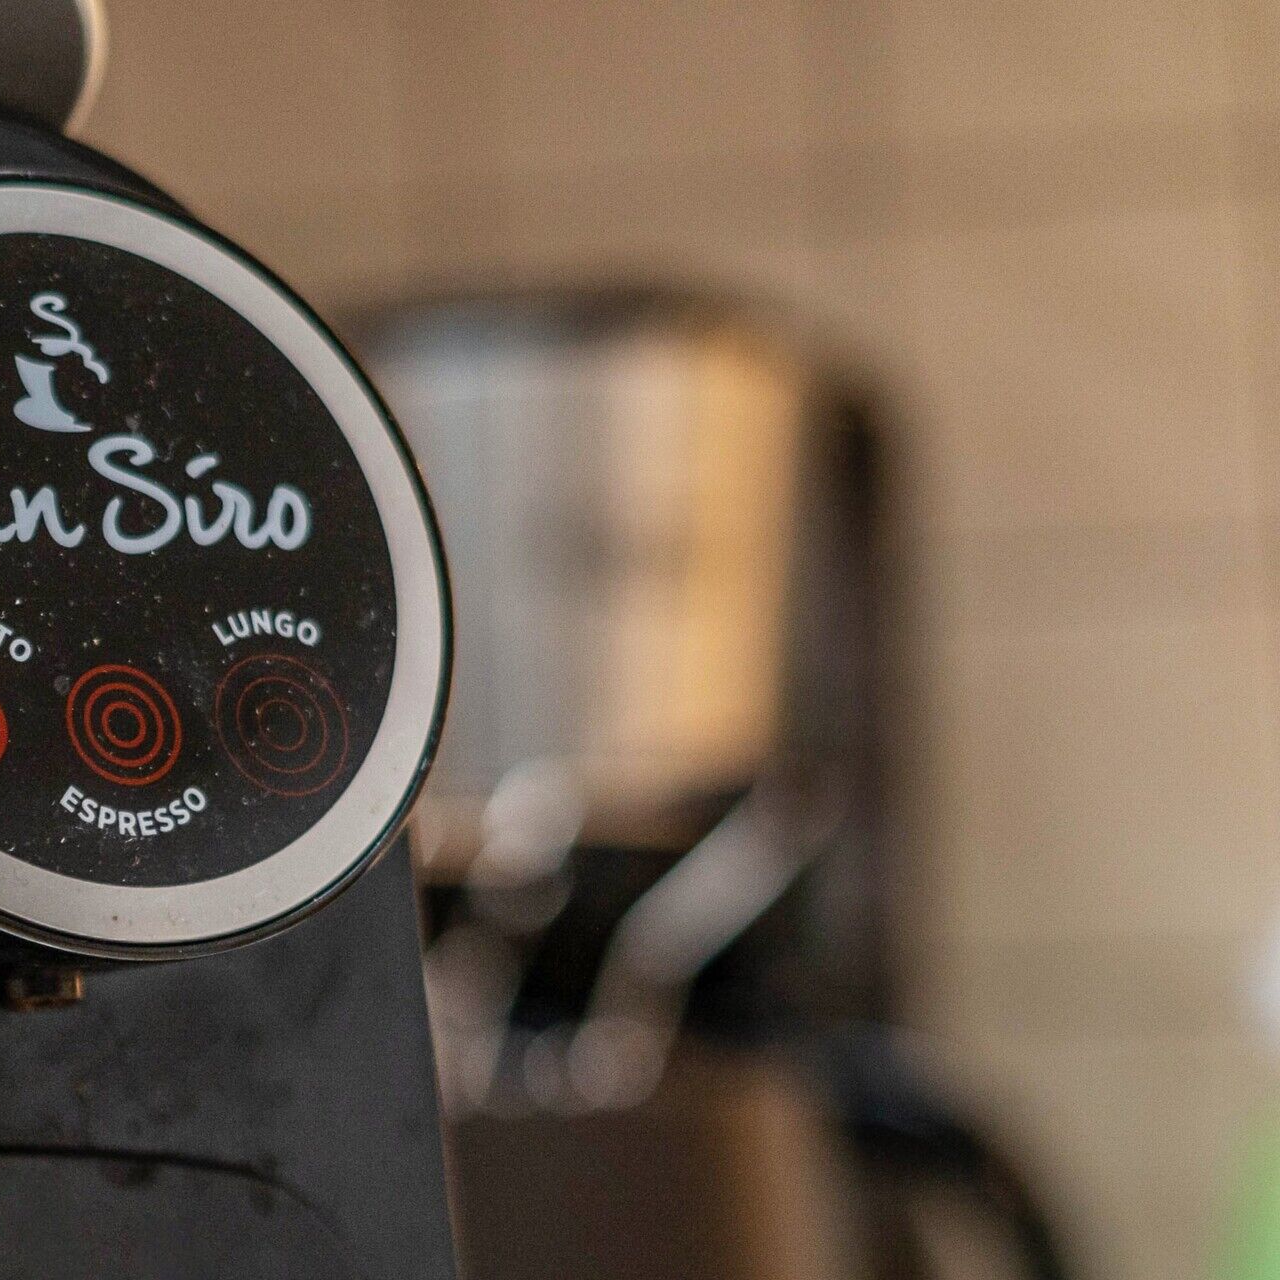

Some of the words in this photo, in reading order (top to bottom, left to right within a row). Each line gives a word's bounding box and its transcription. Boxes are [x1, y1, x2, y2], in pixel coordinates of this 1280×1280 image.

[88, 434, 308, 555] Siro
[210, 608, 322, 648] LUNGO
[58, 785, 208, 838] ESPRESSO
